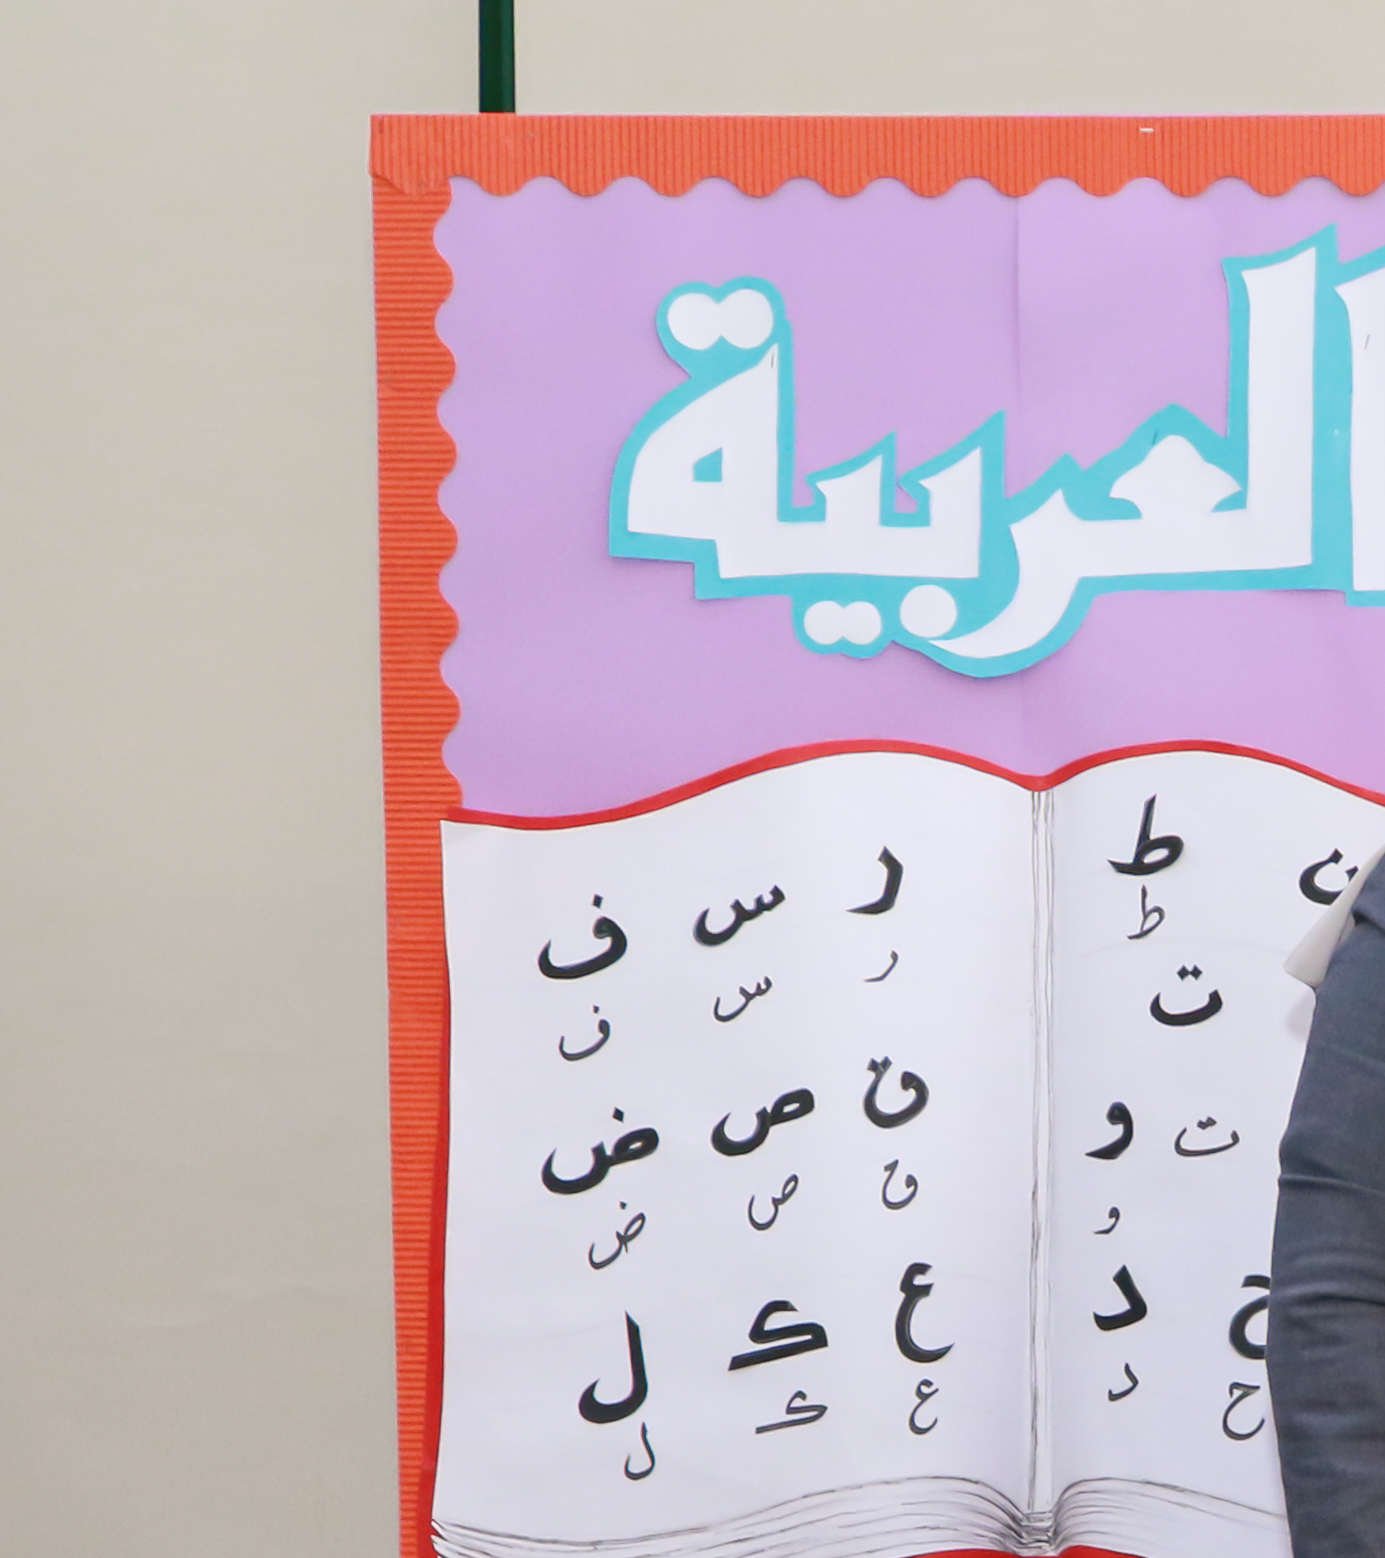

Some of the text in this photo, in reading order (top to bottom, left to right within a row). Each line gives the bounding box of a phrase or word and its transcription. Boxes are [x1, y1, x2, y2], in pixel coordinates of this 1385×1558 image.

[1109, 796, 1183, 875] ط
[537, 847, 903, 980] ر س ف
[1127, 885, 1164, 940] ط
[557, 948, 899, 1062] ر س ف
[1149, 965, 1224, 1027] ت
[540, 1055, 930, 1195] ق ص ض
[1085, 1101, 1241, 1160] ت و
[587, 1201, 647, 1270] ض
[747, 1173, 800, 1231] ص
[1094, 1205, 1122, 1236] و
[894, 1261, 955, 1364] ع
[1093, 1264, 1149, 1333] د
[577, 1312, 649, 1425] ل
[1107, 1361, 1266, 1442] ح د
[908, 1378, 940, 1436] ع
[623, 1421, 657, 1481] ل
